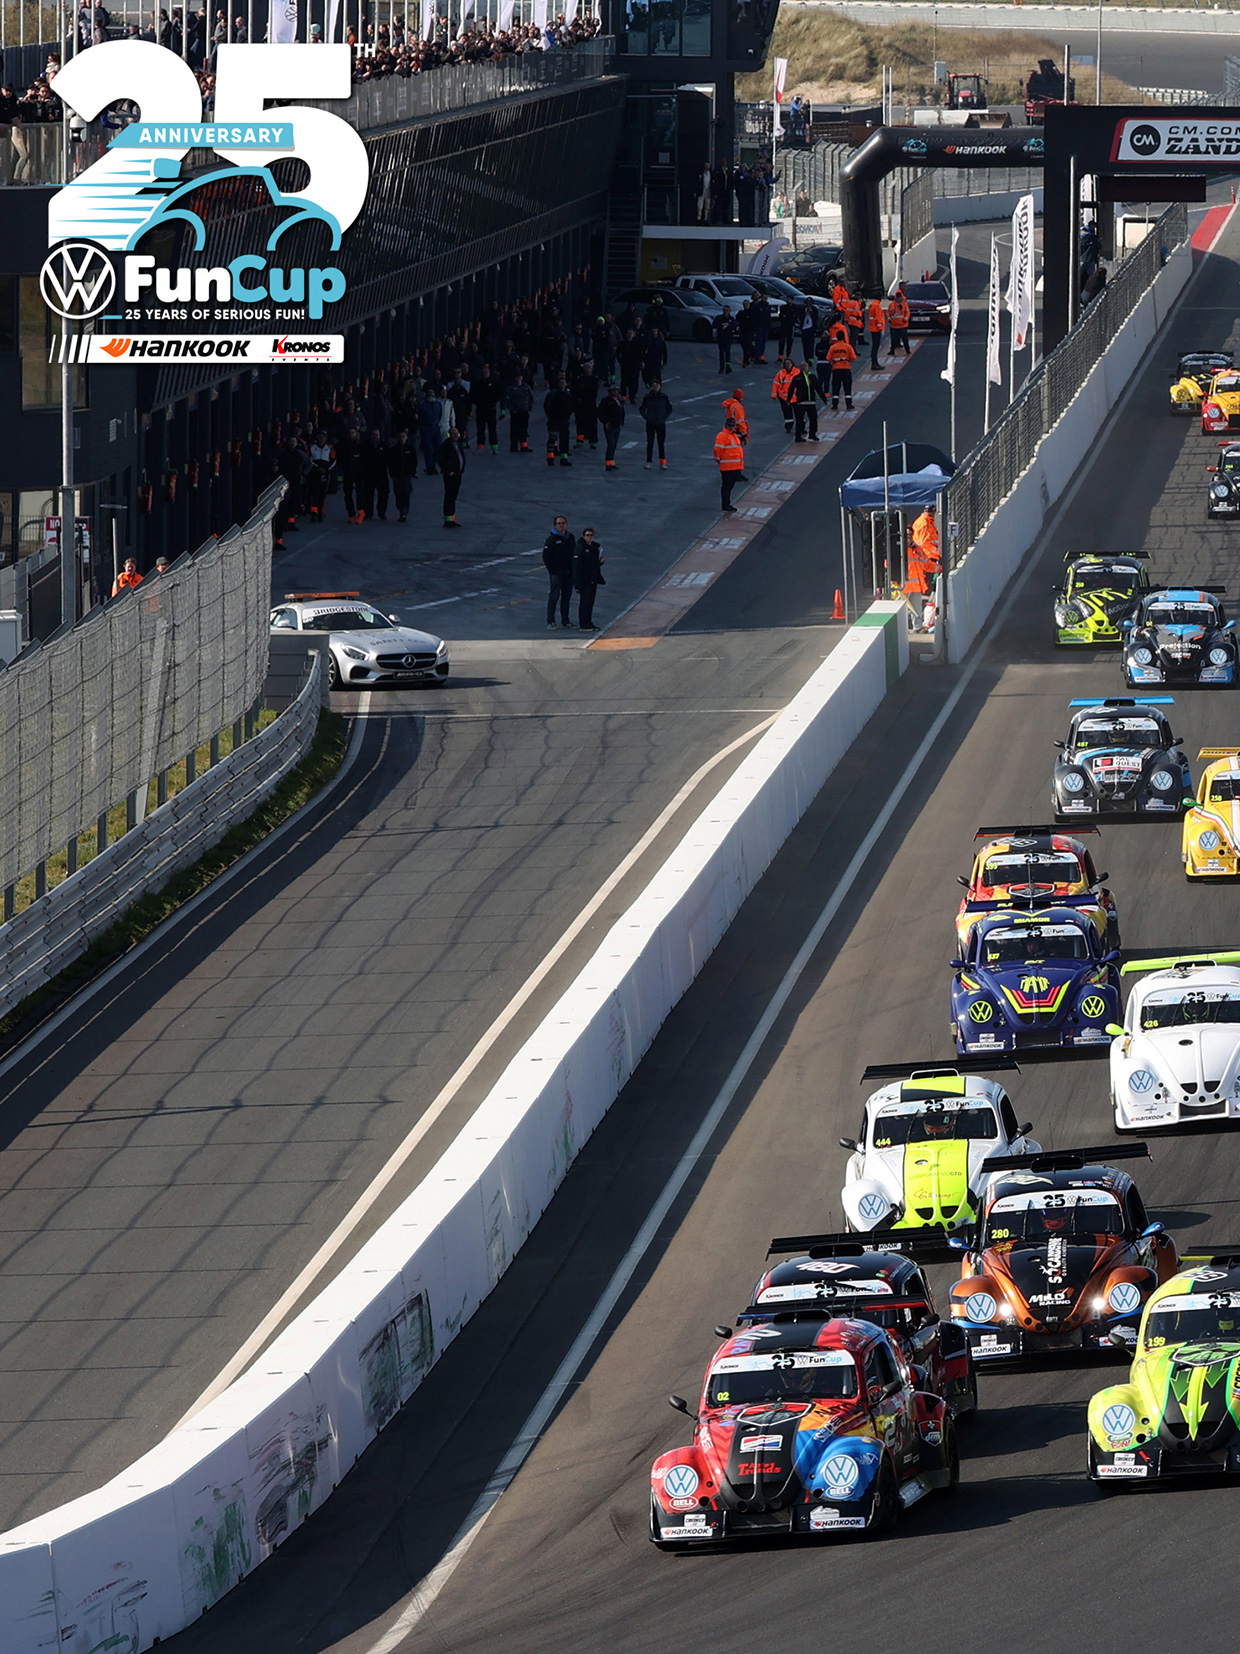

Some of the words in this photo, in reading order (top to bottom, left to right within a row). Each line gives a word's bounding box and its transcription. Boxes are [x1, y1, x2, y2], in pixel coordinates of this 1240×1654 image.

[1186, 991, 1206, 1003] 25
[924, 1099, 945, 1112] 25
[955, 1099, 984, 1108] FunCup
[876, 1138, 891, 1146] 444
[1043, 1194, 1066, 1207] 25
[991, 1229, 1010, 1239] 280
[1147, 1337, 1166, 1347] 199
[809, 1355, 843, 1365] FunCup
[717, 1392, 730, 1401] 02
[830, 1487, 851, 1496] BELL
[673, 1498, 695, 1506] BELL
